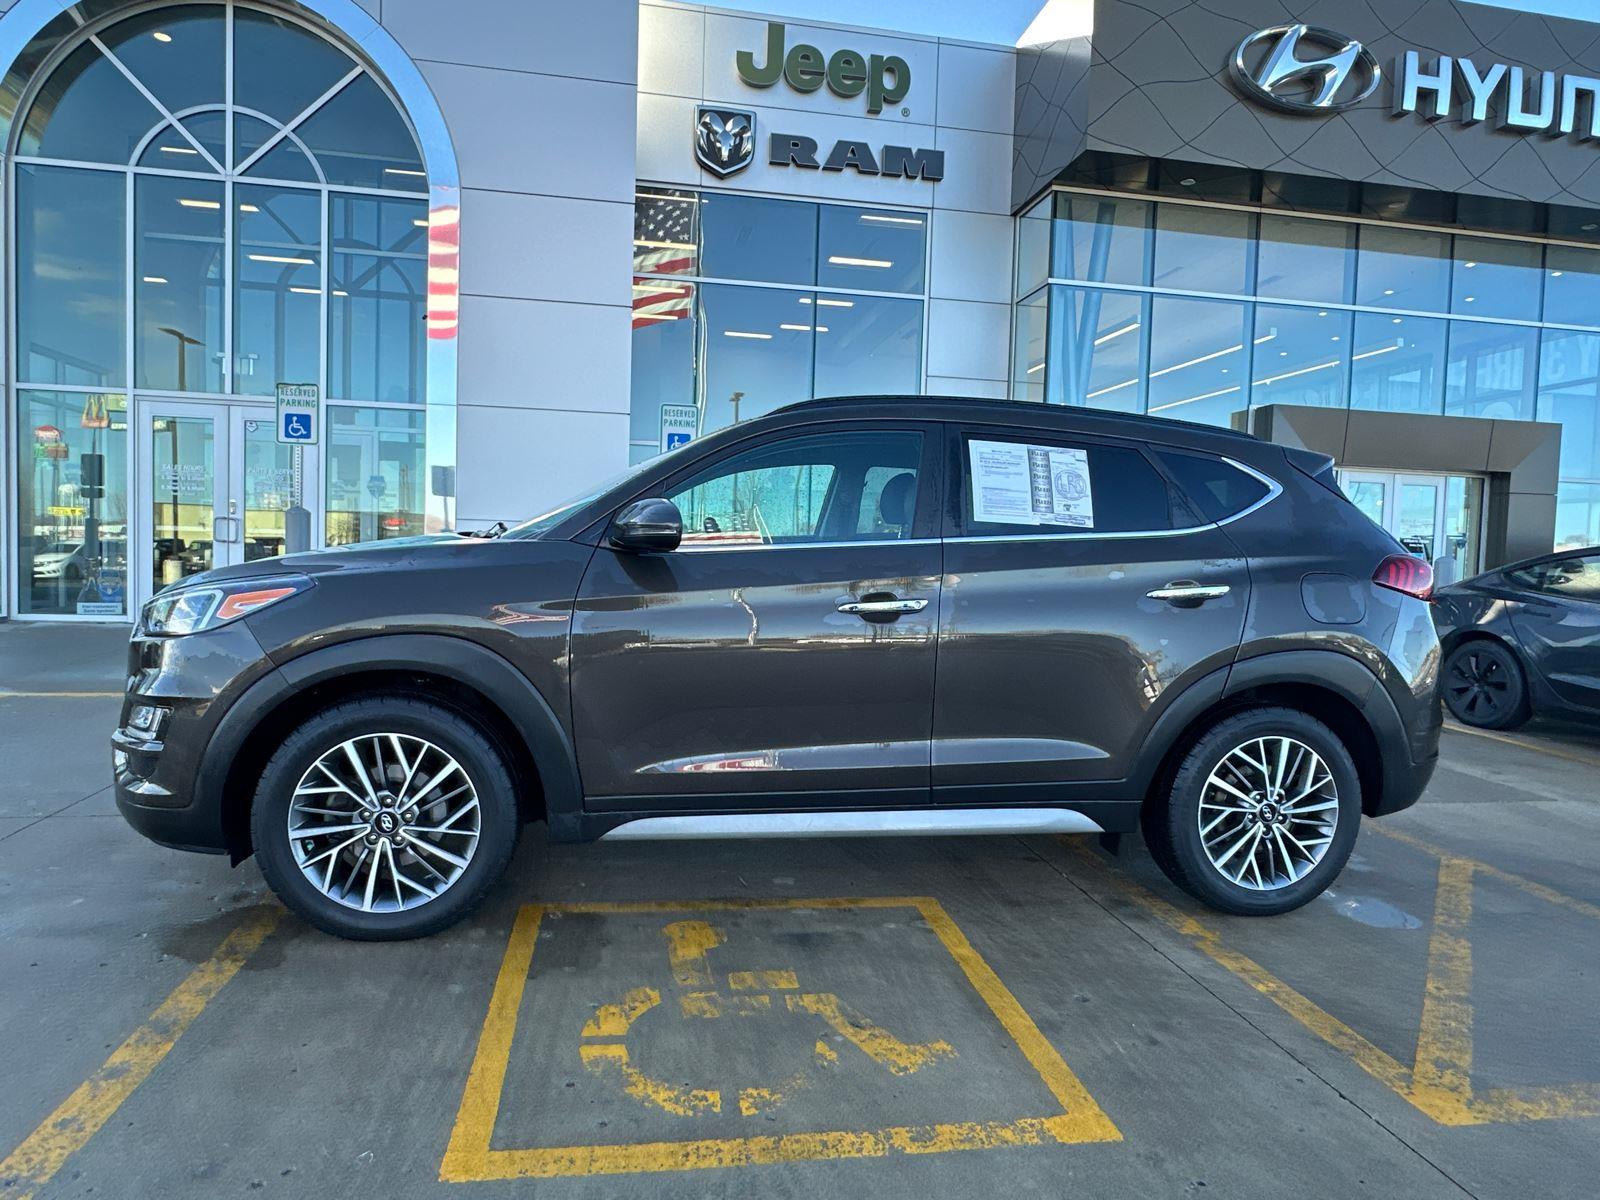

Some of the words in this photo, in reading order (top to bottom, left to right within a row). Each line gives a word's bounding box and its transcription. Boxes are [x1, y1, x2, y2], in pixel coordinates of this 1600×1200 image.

[736, 21, 911, 114] Jeep
[1395, 50, 1600, 140] HYUN
[769, 132, 945, 181] RAM
[281, 387, 316, 397] RESERVED
[280, 398, 316, 408] PARKING
[664, 409, 695, 418] RESERVED
[664, 419, 695, 428] PARKING
